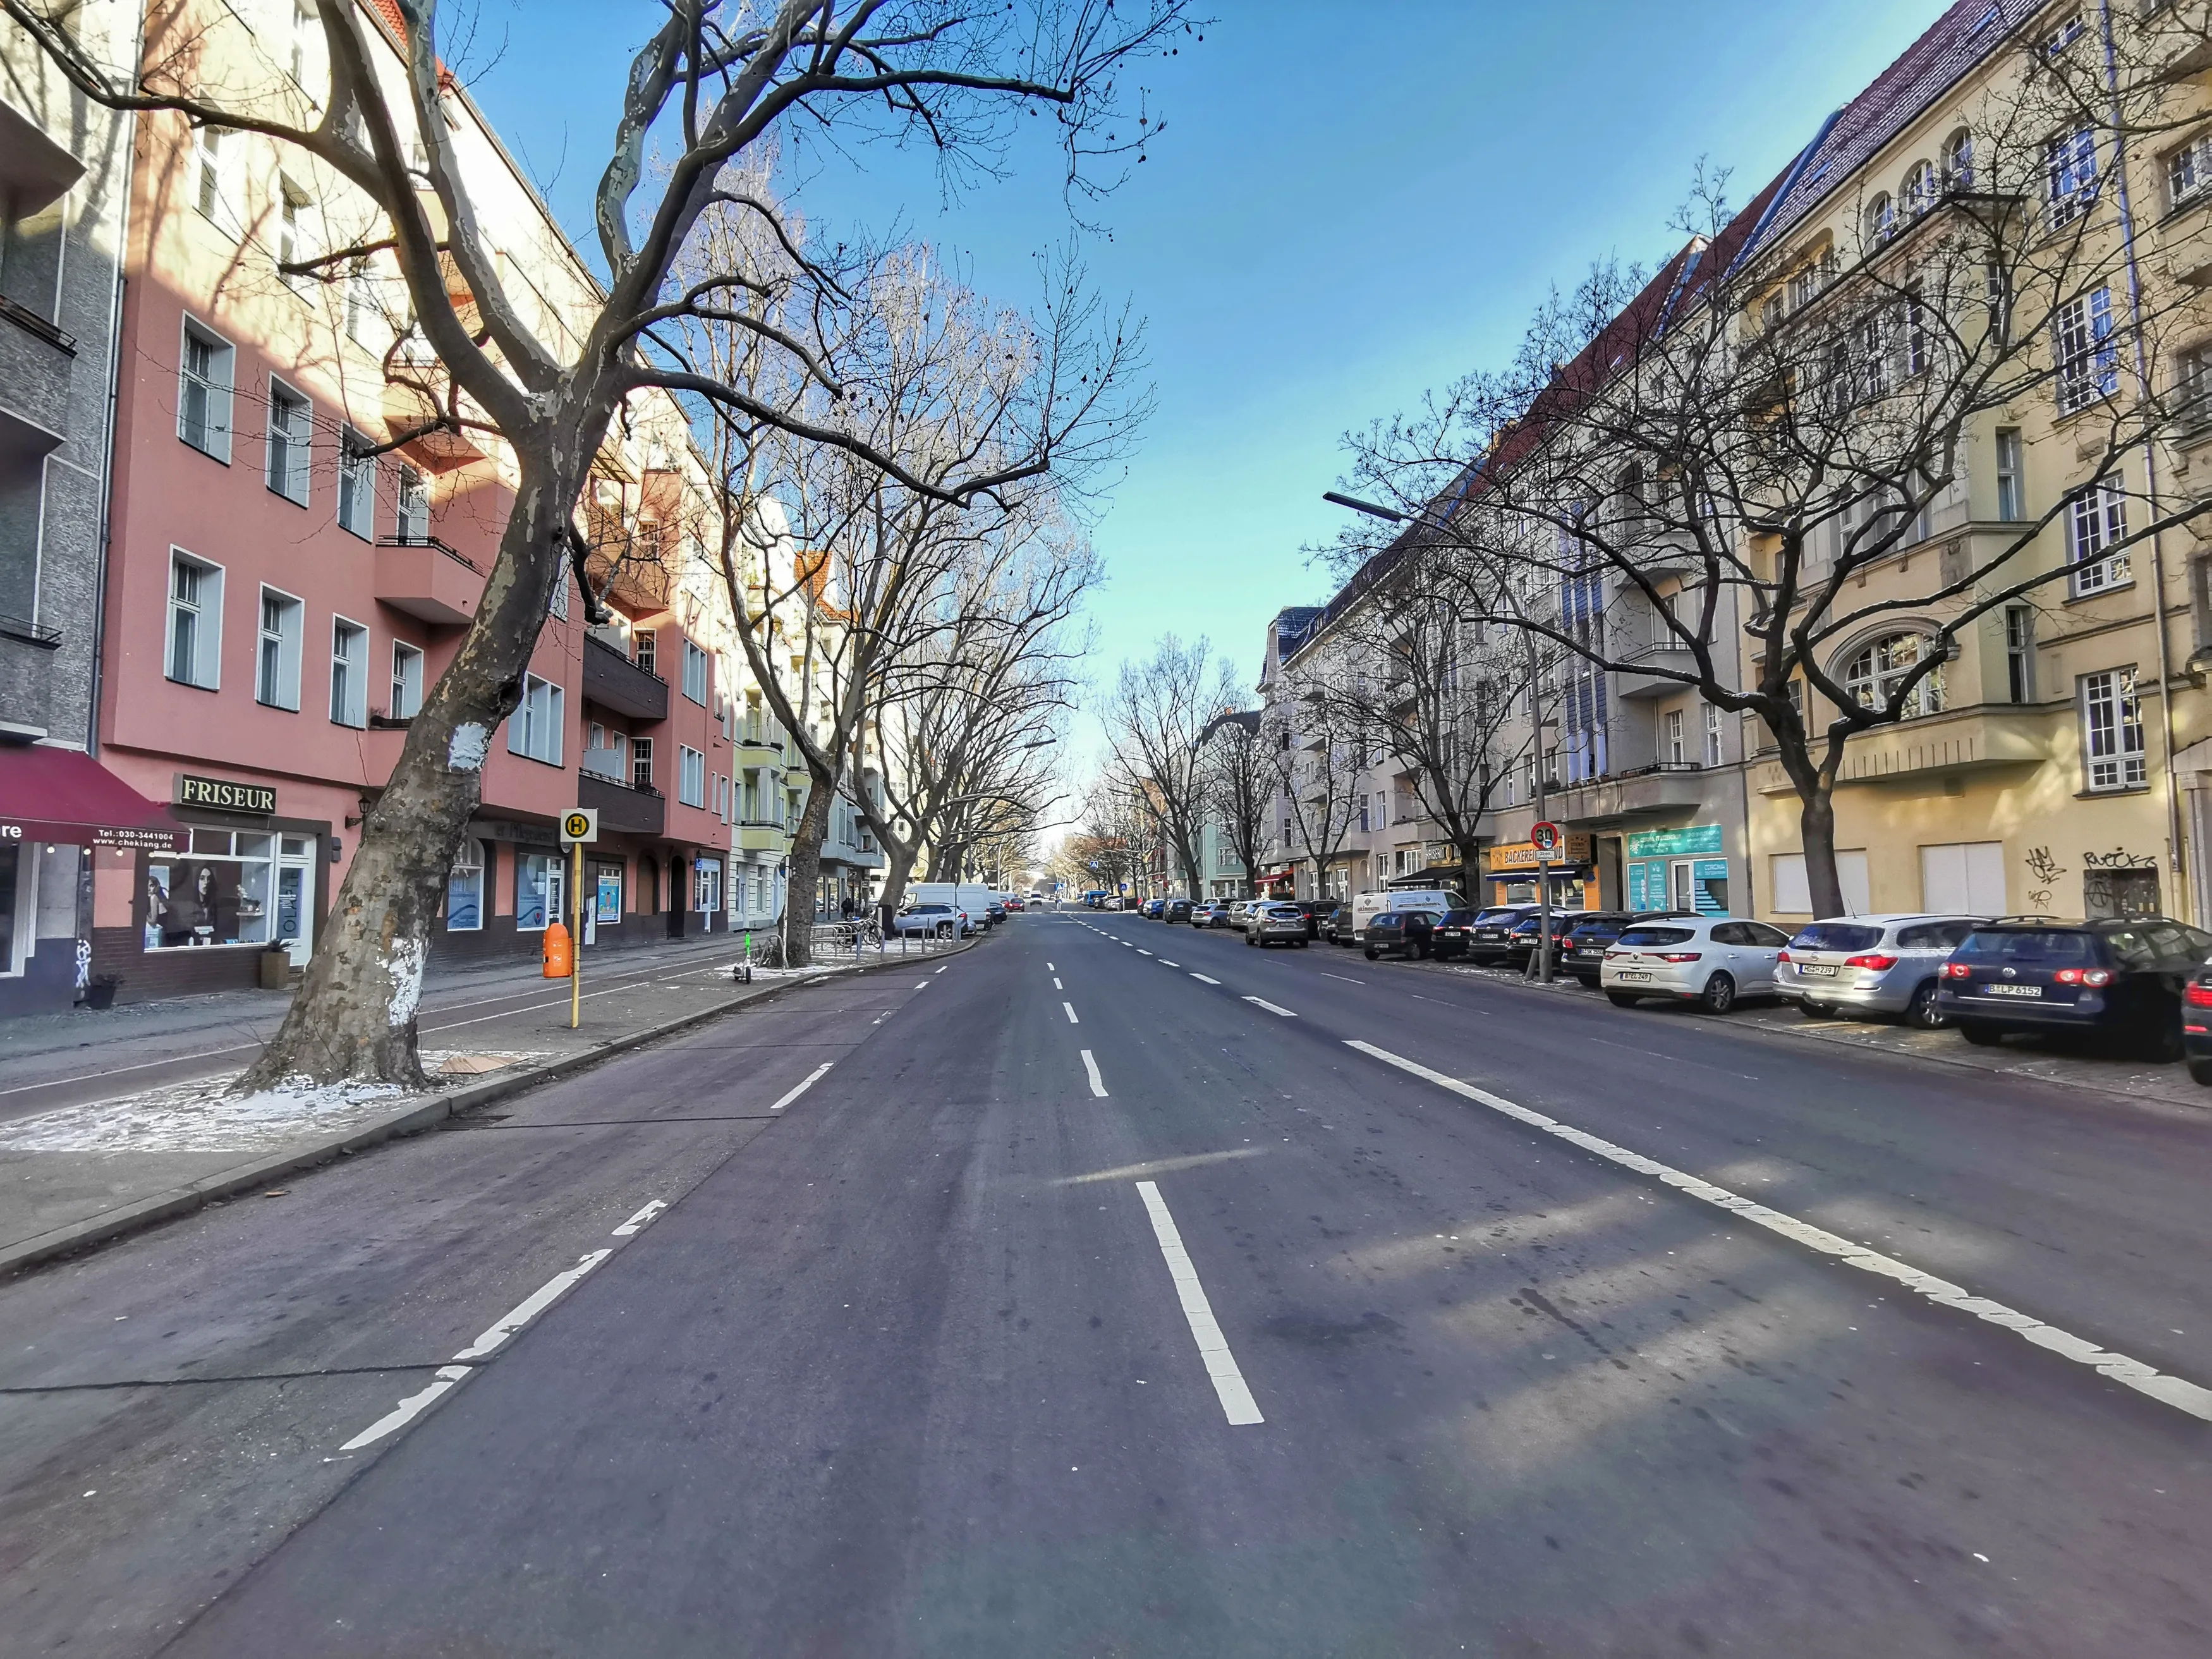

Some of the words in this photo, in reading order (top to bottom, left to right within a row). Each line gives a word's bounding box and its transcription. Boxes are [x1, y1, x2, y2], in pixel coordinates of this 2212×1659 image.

[182, 779, 274, 810] FRISEUR
[0, 825, 22, 838] re
[571, 819, 582, 832] H
[1536, 829, 1552, 842] 30
[93, 837, 172, 849] www.chekiang.de
[1505, 848, 1535, 865] BÄCKEREI
[2015, 987, 2041, 995] 6152
